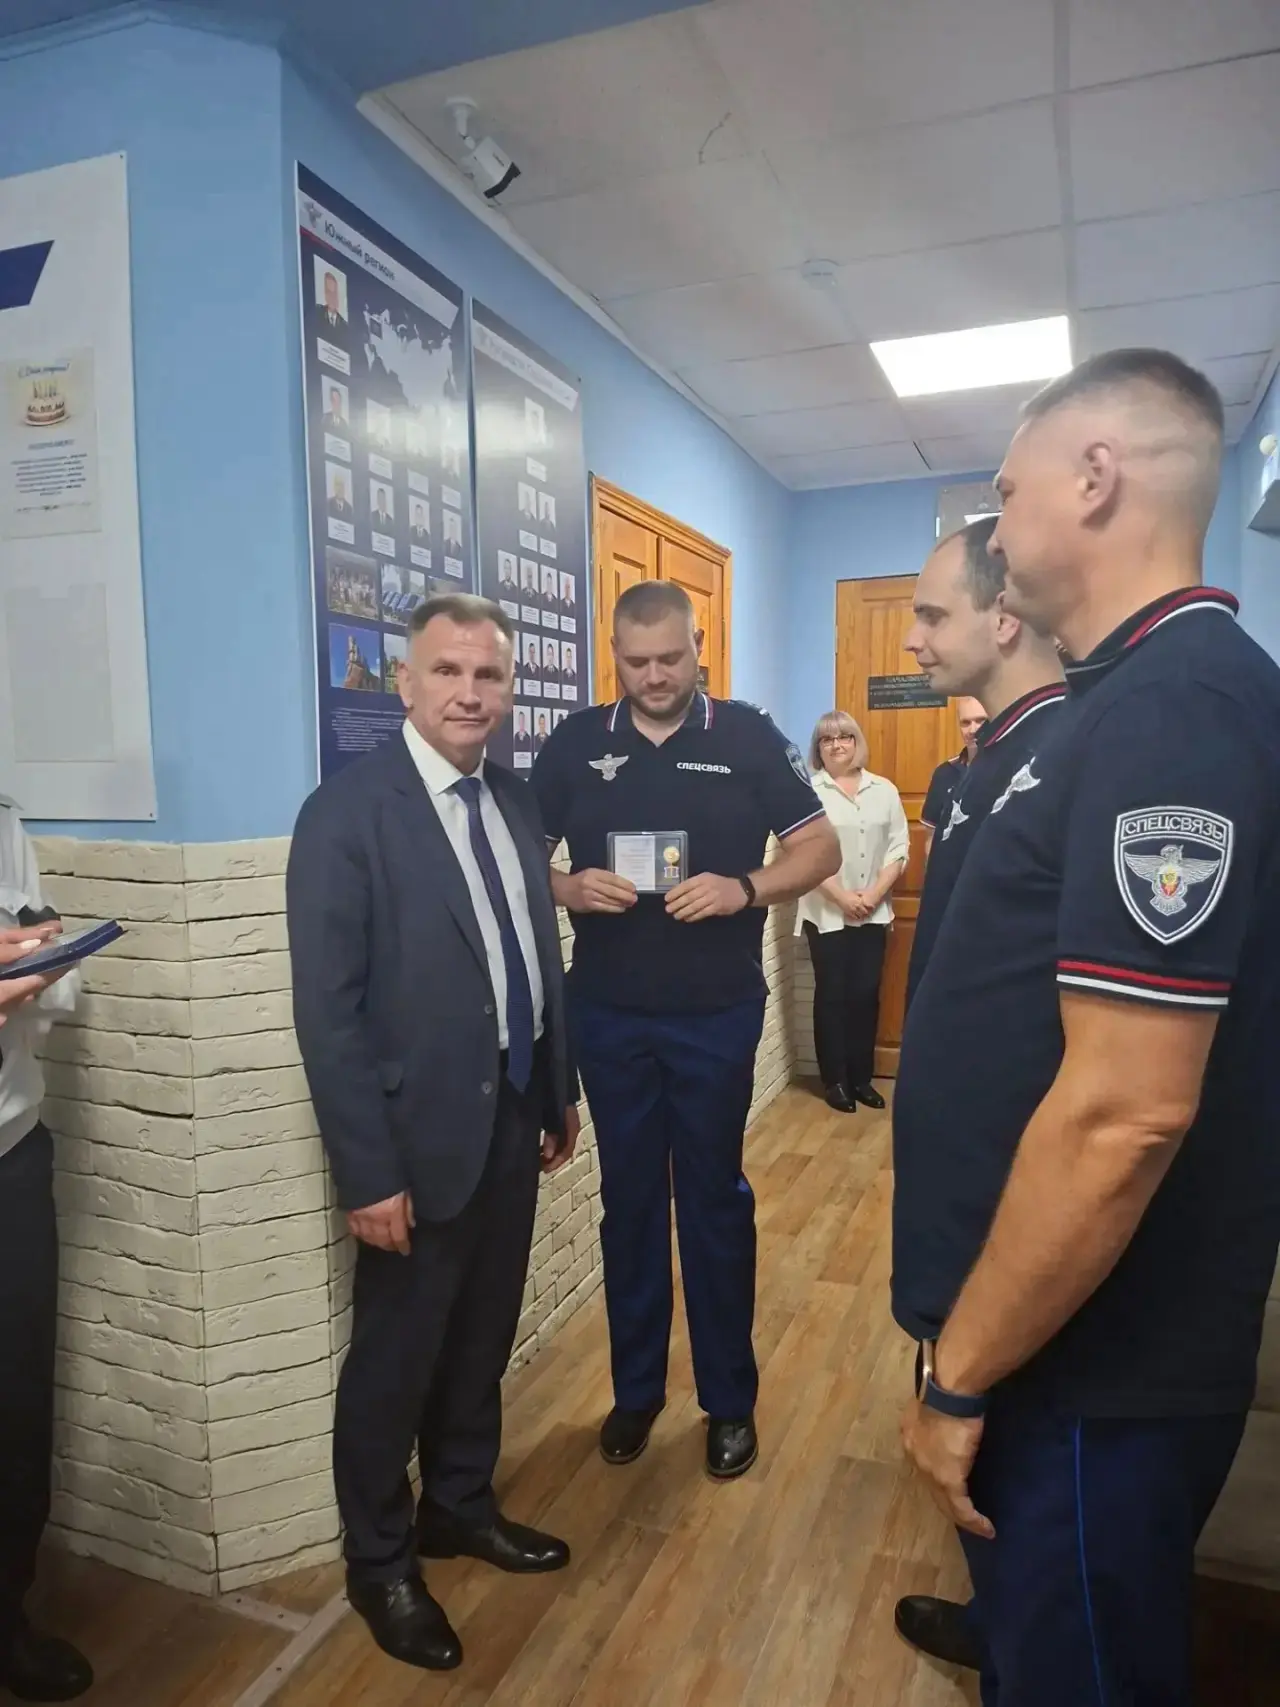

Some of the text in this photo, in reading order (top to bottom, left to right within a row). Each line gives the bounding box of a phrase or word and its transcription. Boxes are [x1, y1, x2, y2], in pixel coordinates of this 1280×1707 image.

[324, 219, 396, 281] Южный регион
[676, 762, 732, 775] СПЕЦСВЯЗЬ
[1125, 816, 1224, 840] СПЕЦСВЯЗЬ
